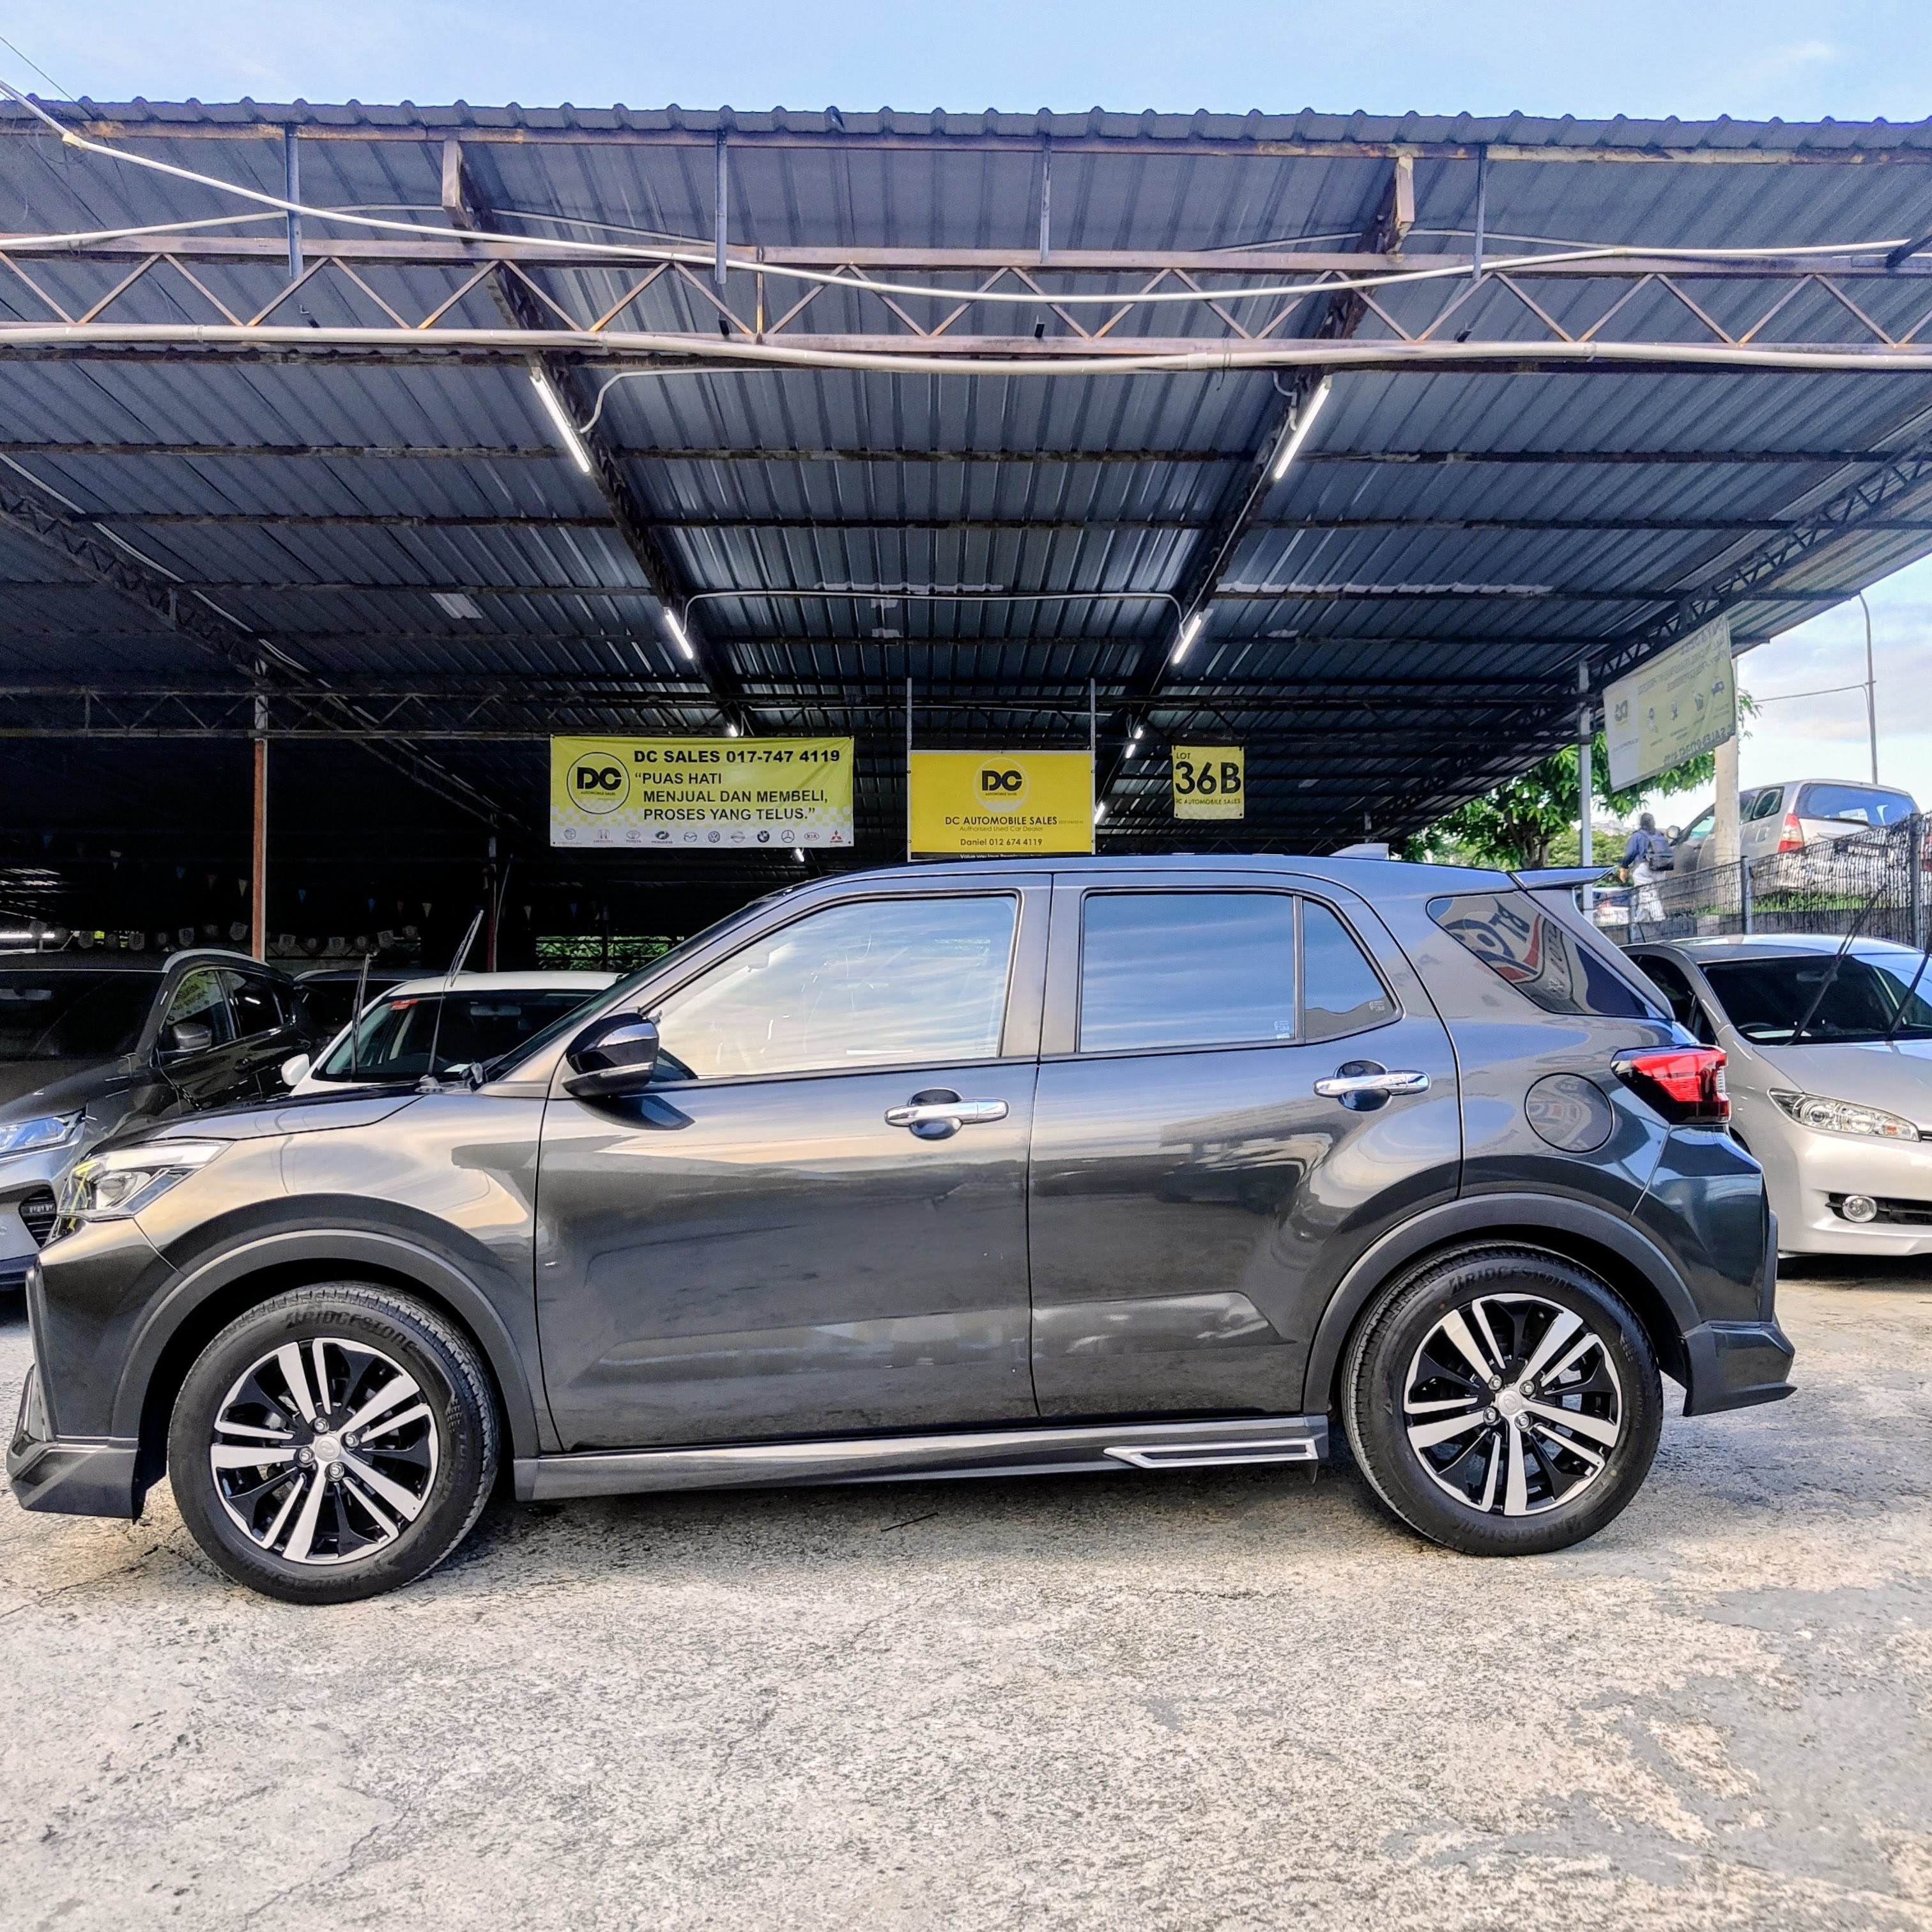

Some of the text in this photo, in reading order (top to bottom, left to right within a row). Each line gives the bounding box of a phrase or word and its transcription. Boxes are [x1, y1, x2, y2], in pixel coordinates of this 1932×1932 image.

[634, 750, 840, 763] DC SALES 017-747 4119
[577, 767, 622, 790] DC
[689, 773, 721, 785] HATI
[982, 770, 1022, 791] DC
[1176, 761, 1241, 795] 36B
[643, 790, 827, 804] MENJUAL DAN MEMBELI,
[644, 809, 705, 820] PROSES
[710, 809, 751, 820] YANG
[946, 816, 960, 825] DC
[963, 816, 1027, 825] AUTOMOBILE
[1029, 816, 1057, 825] SALES
